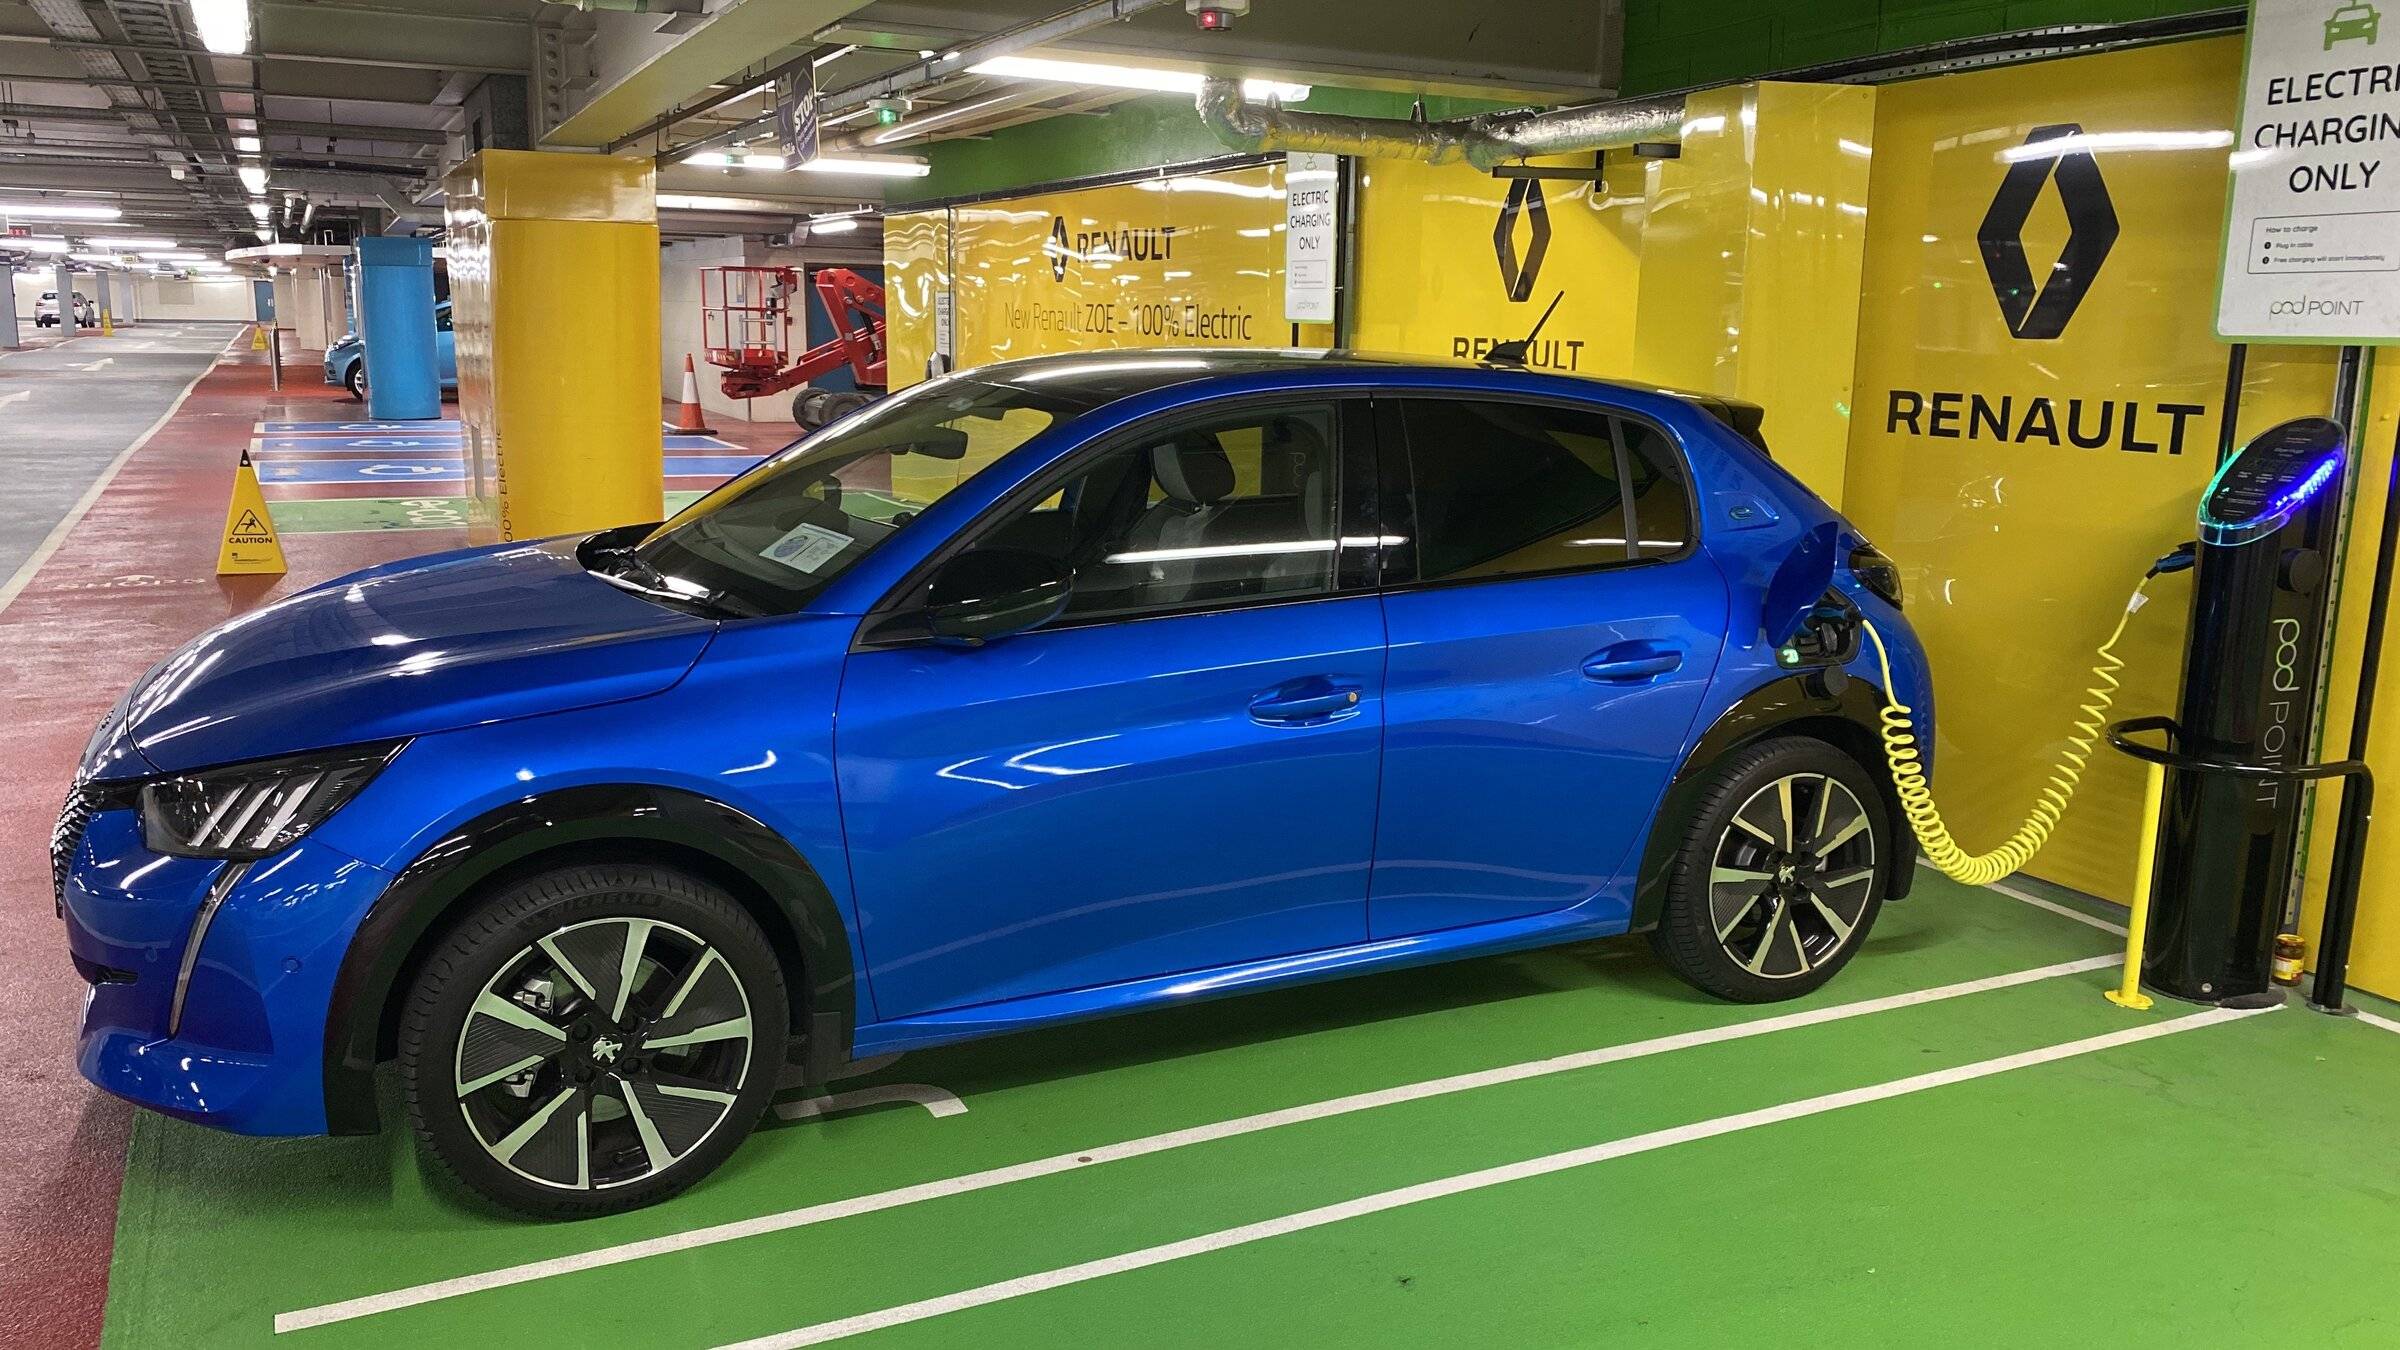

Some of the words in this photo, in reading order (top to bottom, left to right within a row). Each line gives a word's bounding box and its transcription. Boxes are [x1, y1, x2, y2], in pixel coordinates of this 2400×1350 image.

[794, 88, 814, 133] STOP
[2289, 160, 2381, 193] ONLY
[1292, 190, 1329, 207] ELECTRIC
[1290, 213, 1331, 229] CHARGING
[1077, 226, 1176, 264] RENAULT
[1299, 236, 1321, 250] ONLY
[1004, 302, 1031, 330] New
[1034, 303, 1082, 332] Renault
[1085, 304, 1115, 334] ZOE
[1132, 304, 1180, 337] 100%
[1184, 305, 1252, 340] Electric
[2269, 295, 2306, 320] pod
[2308, 301, 2364, 315] POINT
[1453, 337, 1585, 371] REULT
[1887, 389, 2206, 455] RENAULT
[2272, 618, 2300, 692] pod
